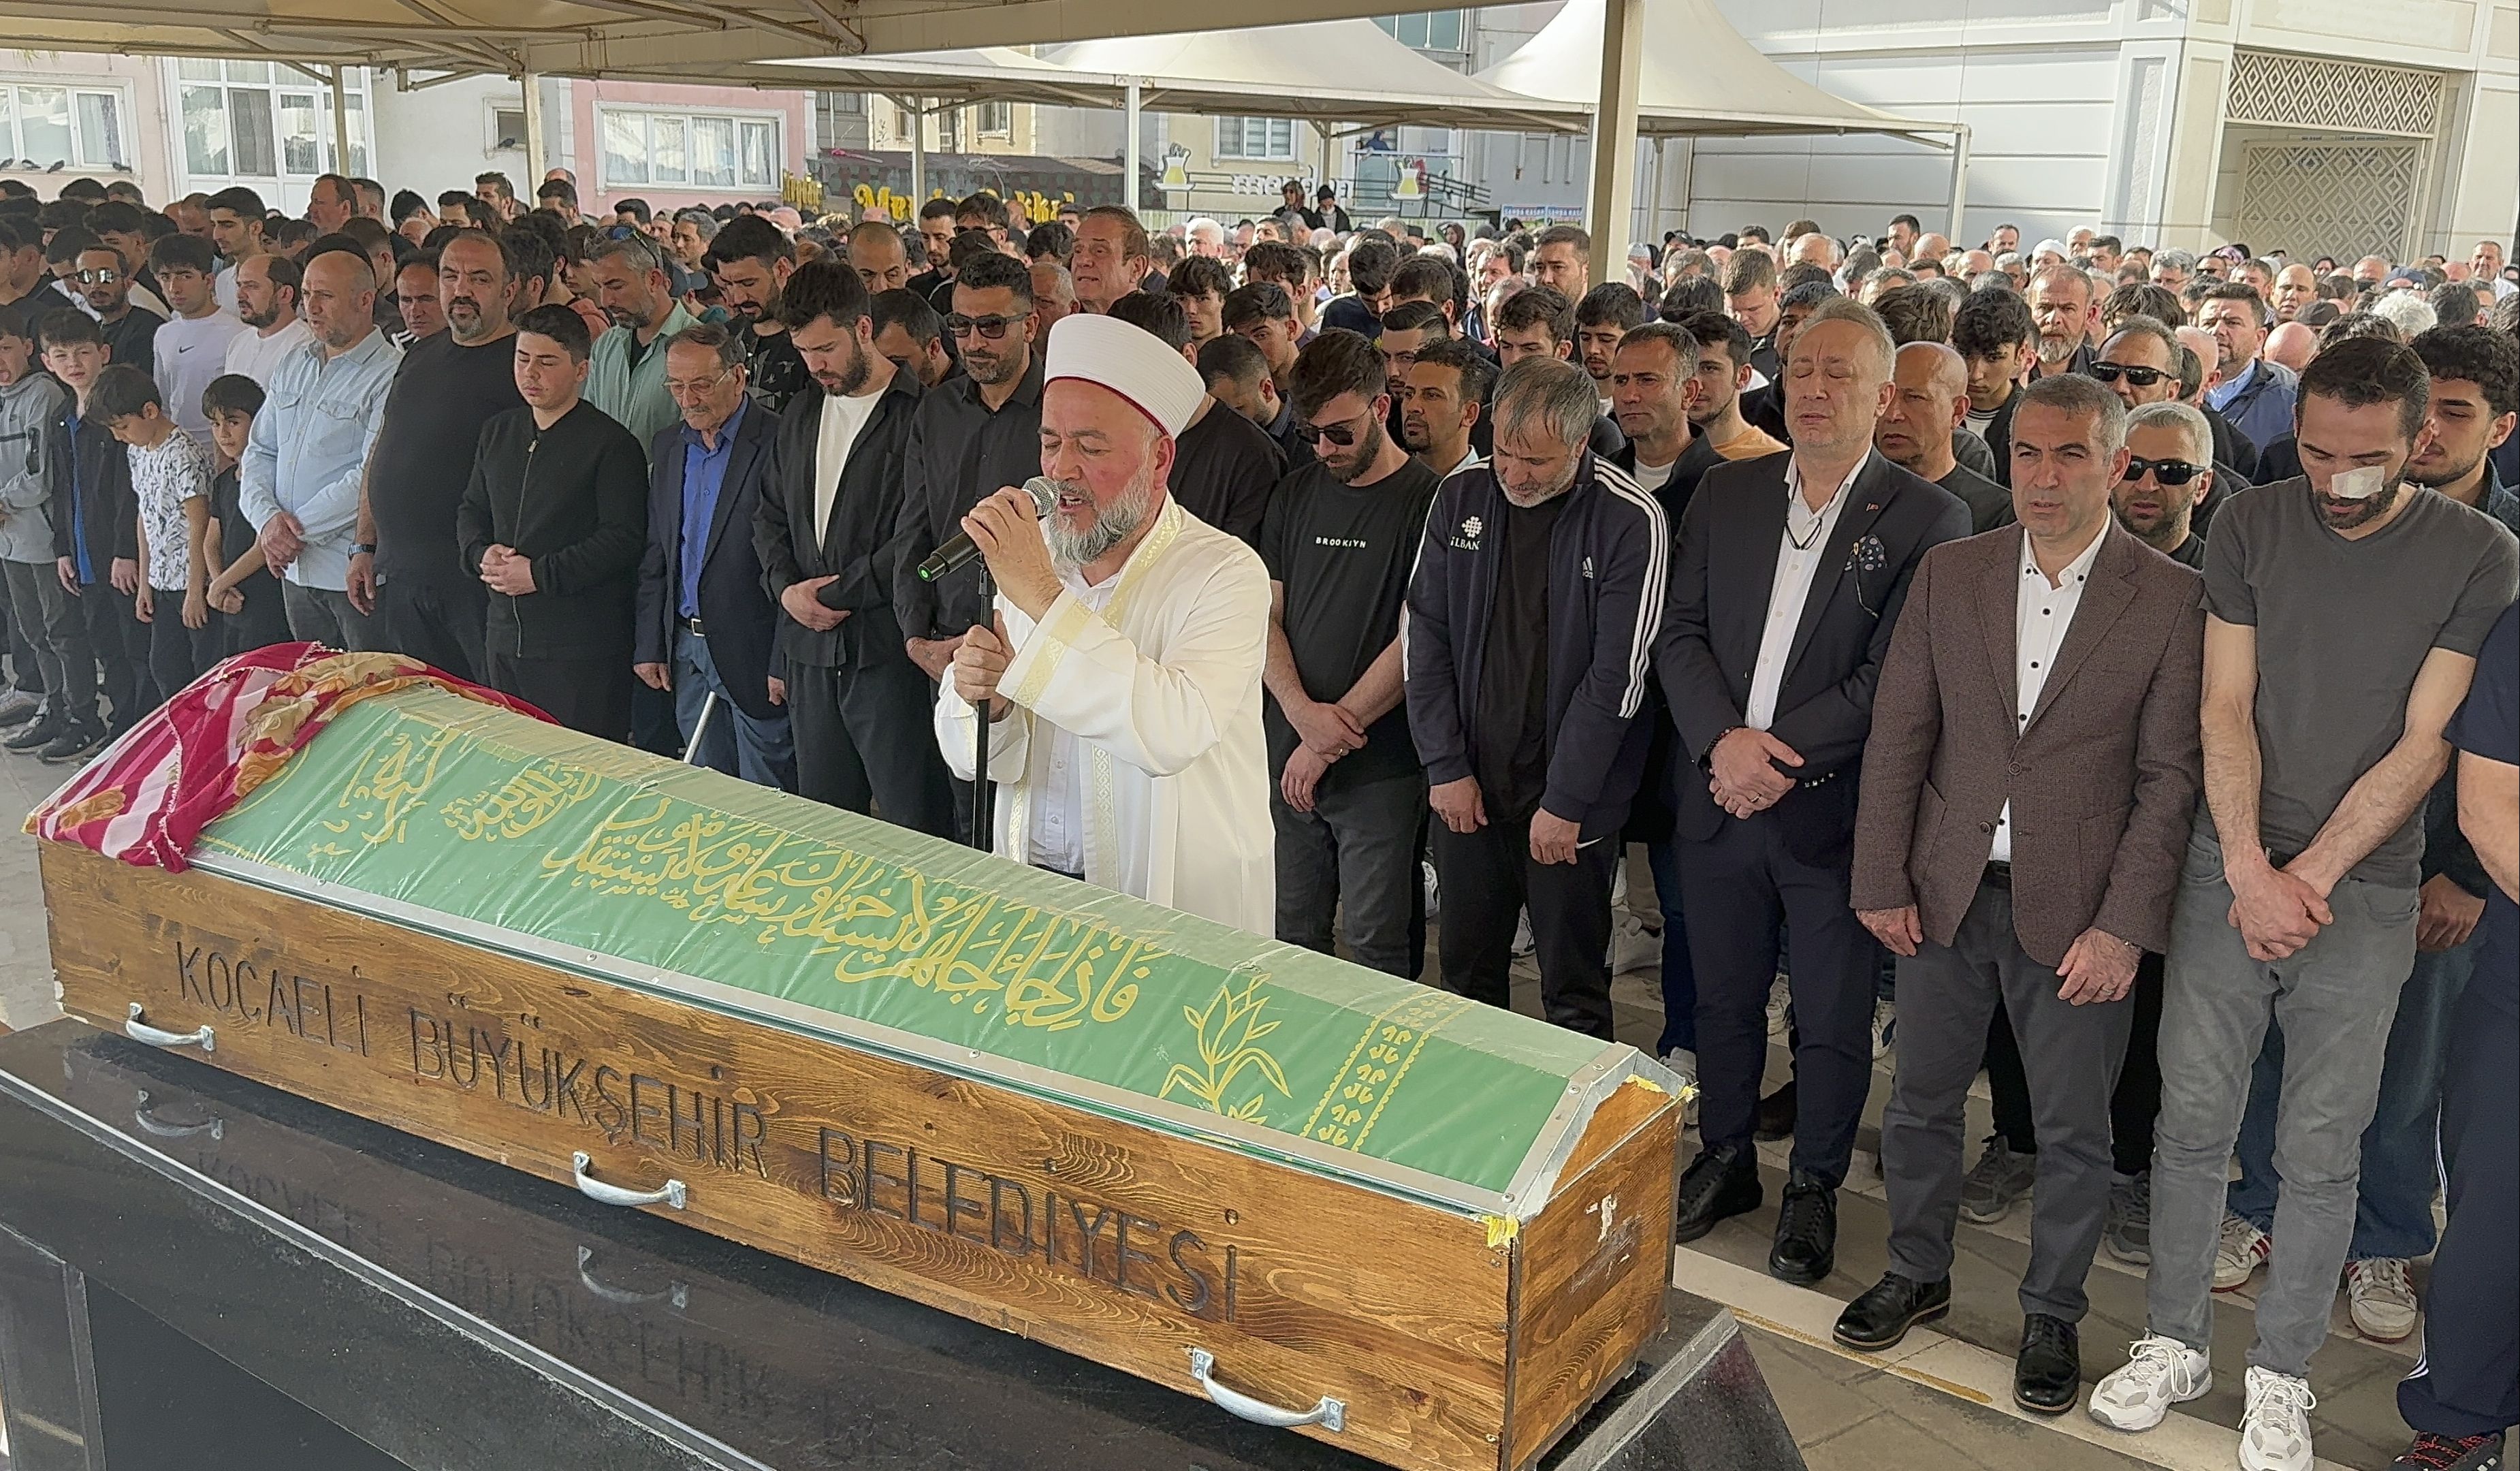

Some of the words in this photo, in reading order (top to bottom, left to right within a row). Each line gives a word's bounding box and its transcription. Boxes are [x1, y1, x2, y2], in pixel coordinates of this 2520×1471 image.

[176, 940, 368, 1058] KOCAELİ
[409, 992, 768, 1179] BÜYÜKŞEHİR
[819, 1126, 1238, 1323] BELEDİYESİ
